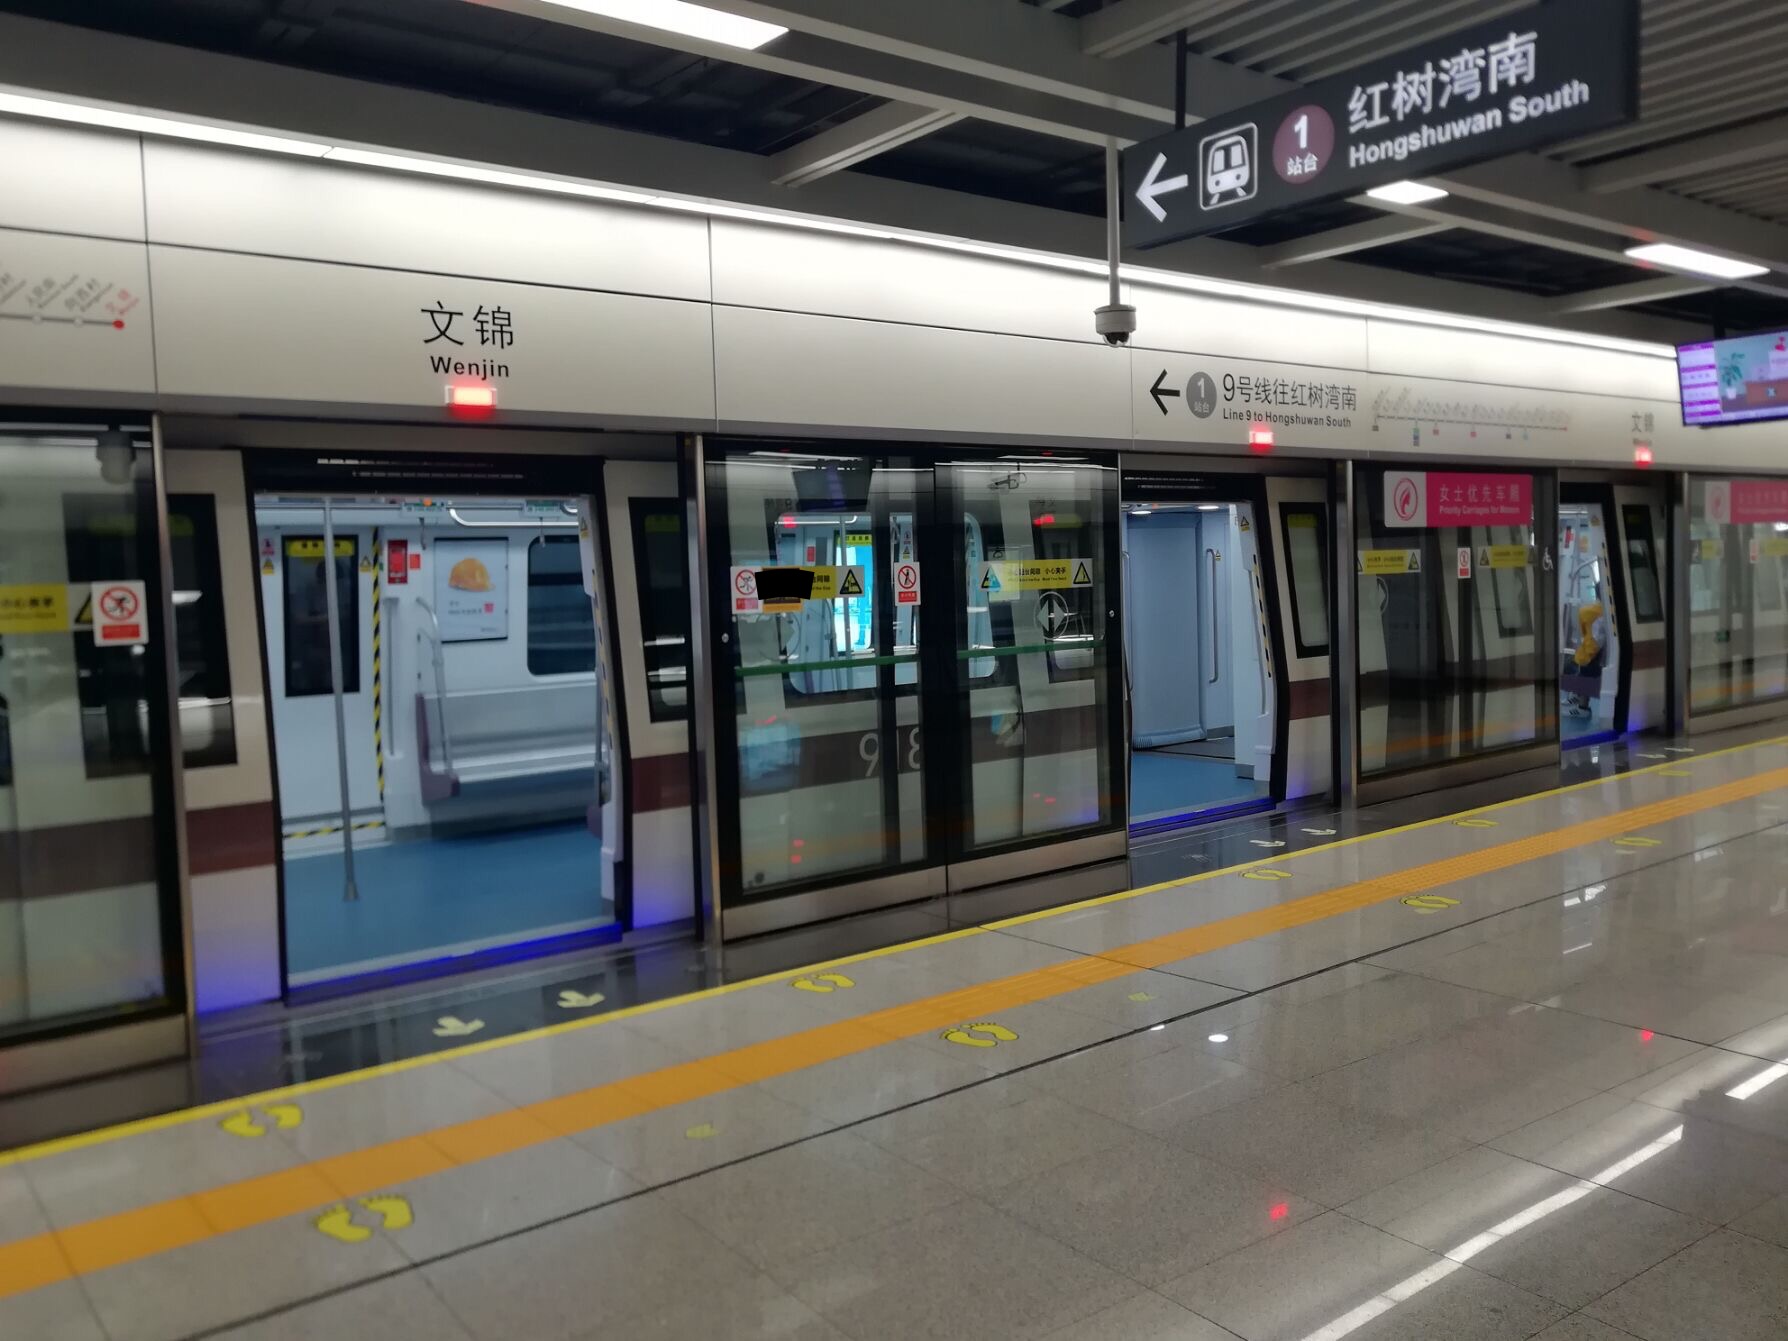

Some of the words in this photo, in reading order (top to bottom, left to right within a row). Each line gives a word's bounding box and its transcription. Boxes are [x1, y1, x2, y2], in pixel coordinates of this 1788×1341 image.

[1348, 31, 1538, 133] 红树湾南
[1294, 115, 1308, 148] 1
[1350, 107, 1502, 168] Hongshuwan
[1508, 78, 1590, 123] South
[1286, 154, 1319, 175] 站台
[421, 301, 513, 349] 文锦
[430, 356, 509, 381] Wenjin
[1197, 378, 1206, 399] 1
[1223, 373, 1357, 411] 9号线往红树湾南
[1223, 408, 1244, 421] Line
[1246, 410, 1252, 421] 9
[1254, 410, 1263, 422] to
[1265, 412, 1325, 427] Hongshuwan
[1326, 416, 1352, 428] South
